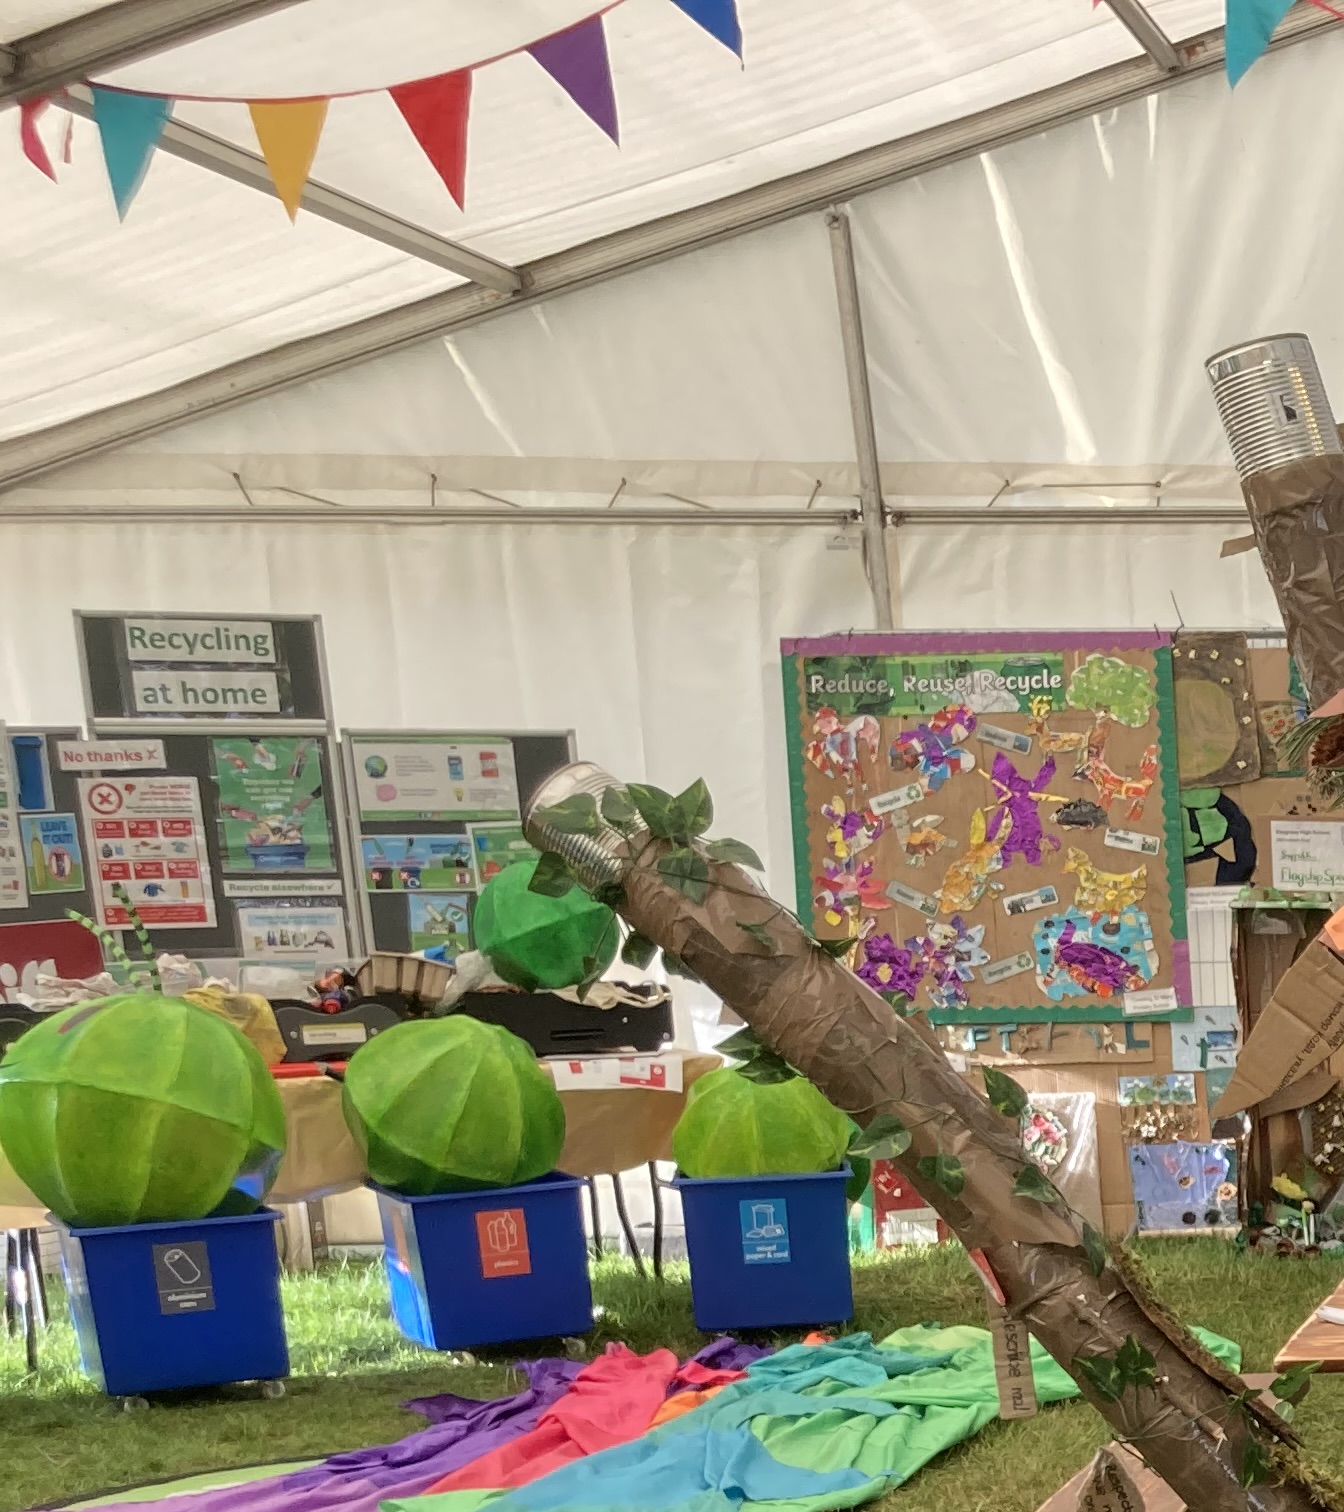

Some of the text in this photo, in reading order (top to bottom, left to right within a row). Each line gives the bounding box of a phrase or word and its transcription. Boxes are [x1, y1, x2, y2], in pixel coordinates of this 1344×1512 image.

[128, 626, 271, 657] Recycling
[810, 668, 1062, 697] Reduce, Reuse, Recycle
[143, 680, 267, 705] at home
[63, 749, 144, 763] No thanks
[40, 820, 68, 833] LEAVE
[229, 882, 325, 892] Recycle elsewhere
